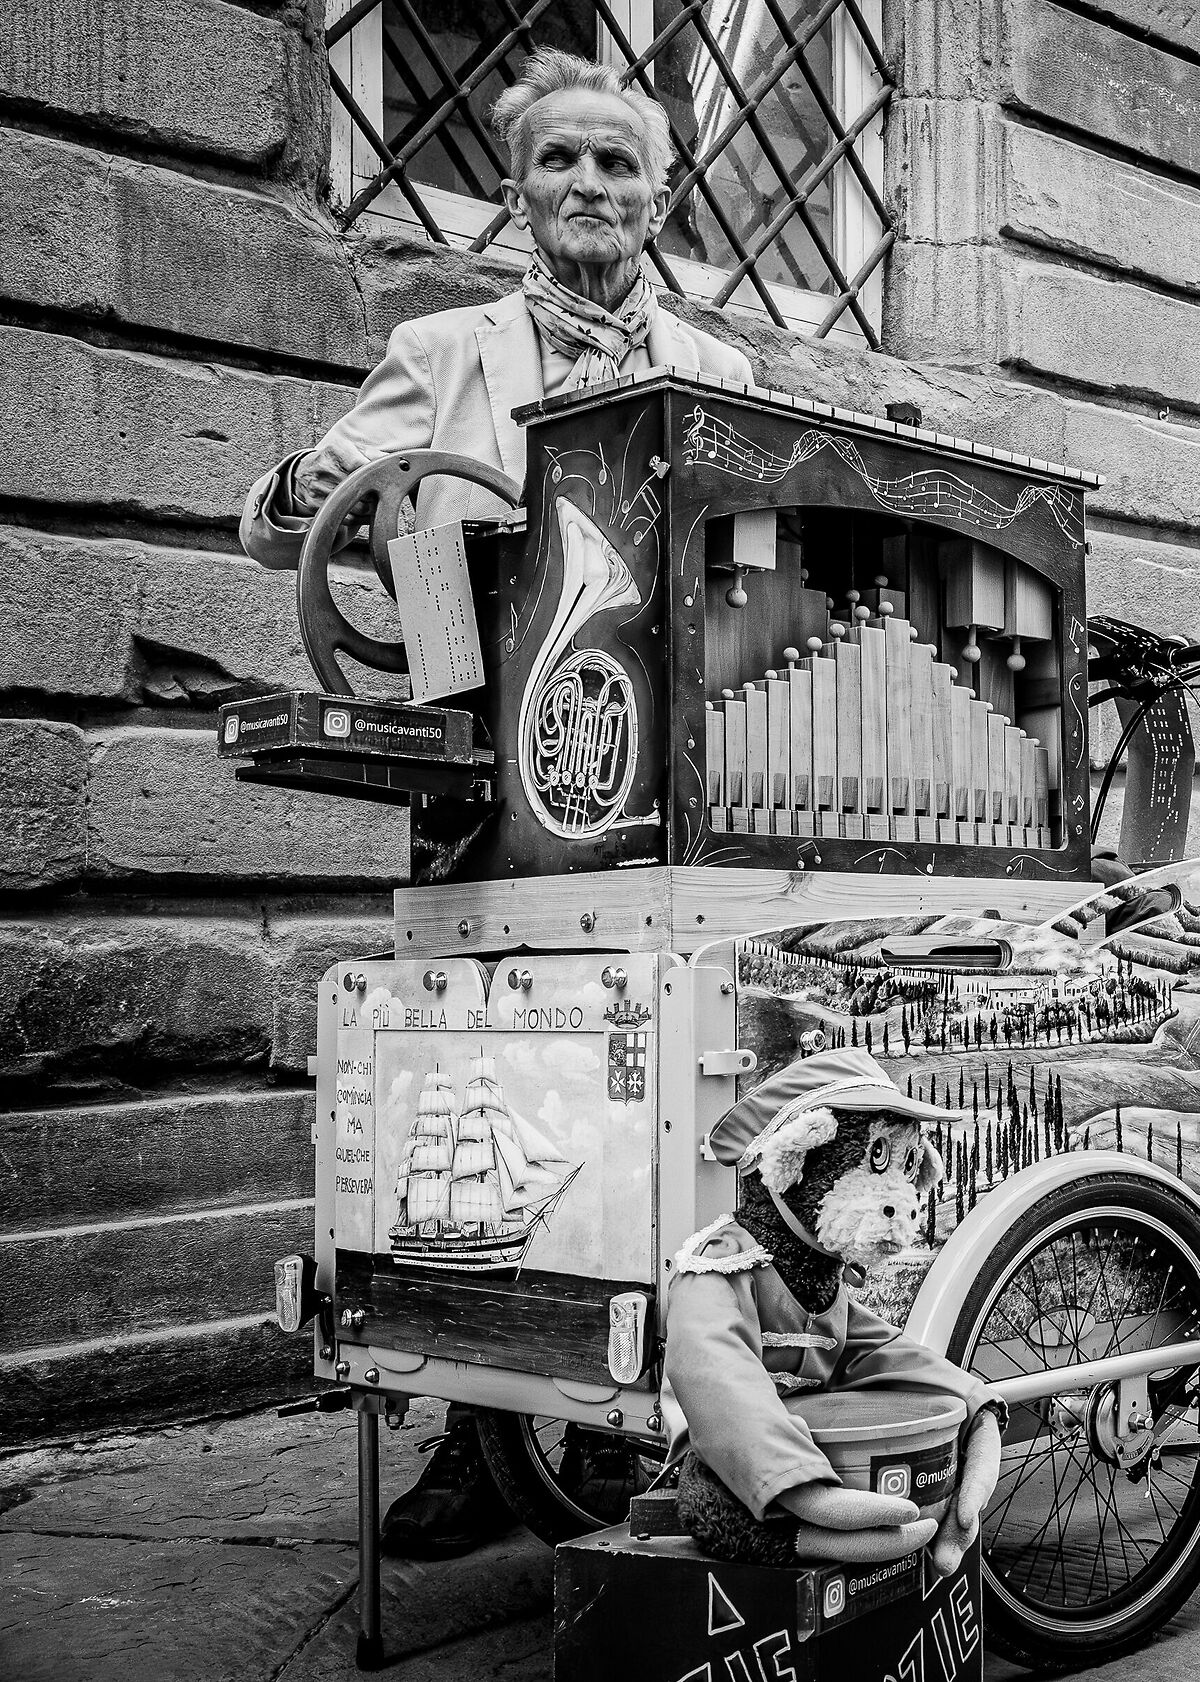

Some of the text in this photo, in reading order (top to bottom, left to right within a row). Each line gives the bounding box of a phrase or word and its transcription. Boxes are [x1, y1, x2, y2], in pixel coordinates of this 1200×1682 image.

[240, 714, 288, 732] @musicavanti50
[354, 719, 442, 738] @musicavanti50
[342, 1007, 358, 1027] LA
[404, 1008, 447, 1030] BELLA
[467, 1008, 493, 1029] DEL
[513, 1006, 584, 1030] MONDO
[346, 1116, 364, 1134] MA
[335, 1175, 373, 1194] PERSEVERA
[848, 1552, 918, 1596] @musicavanti50
